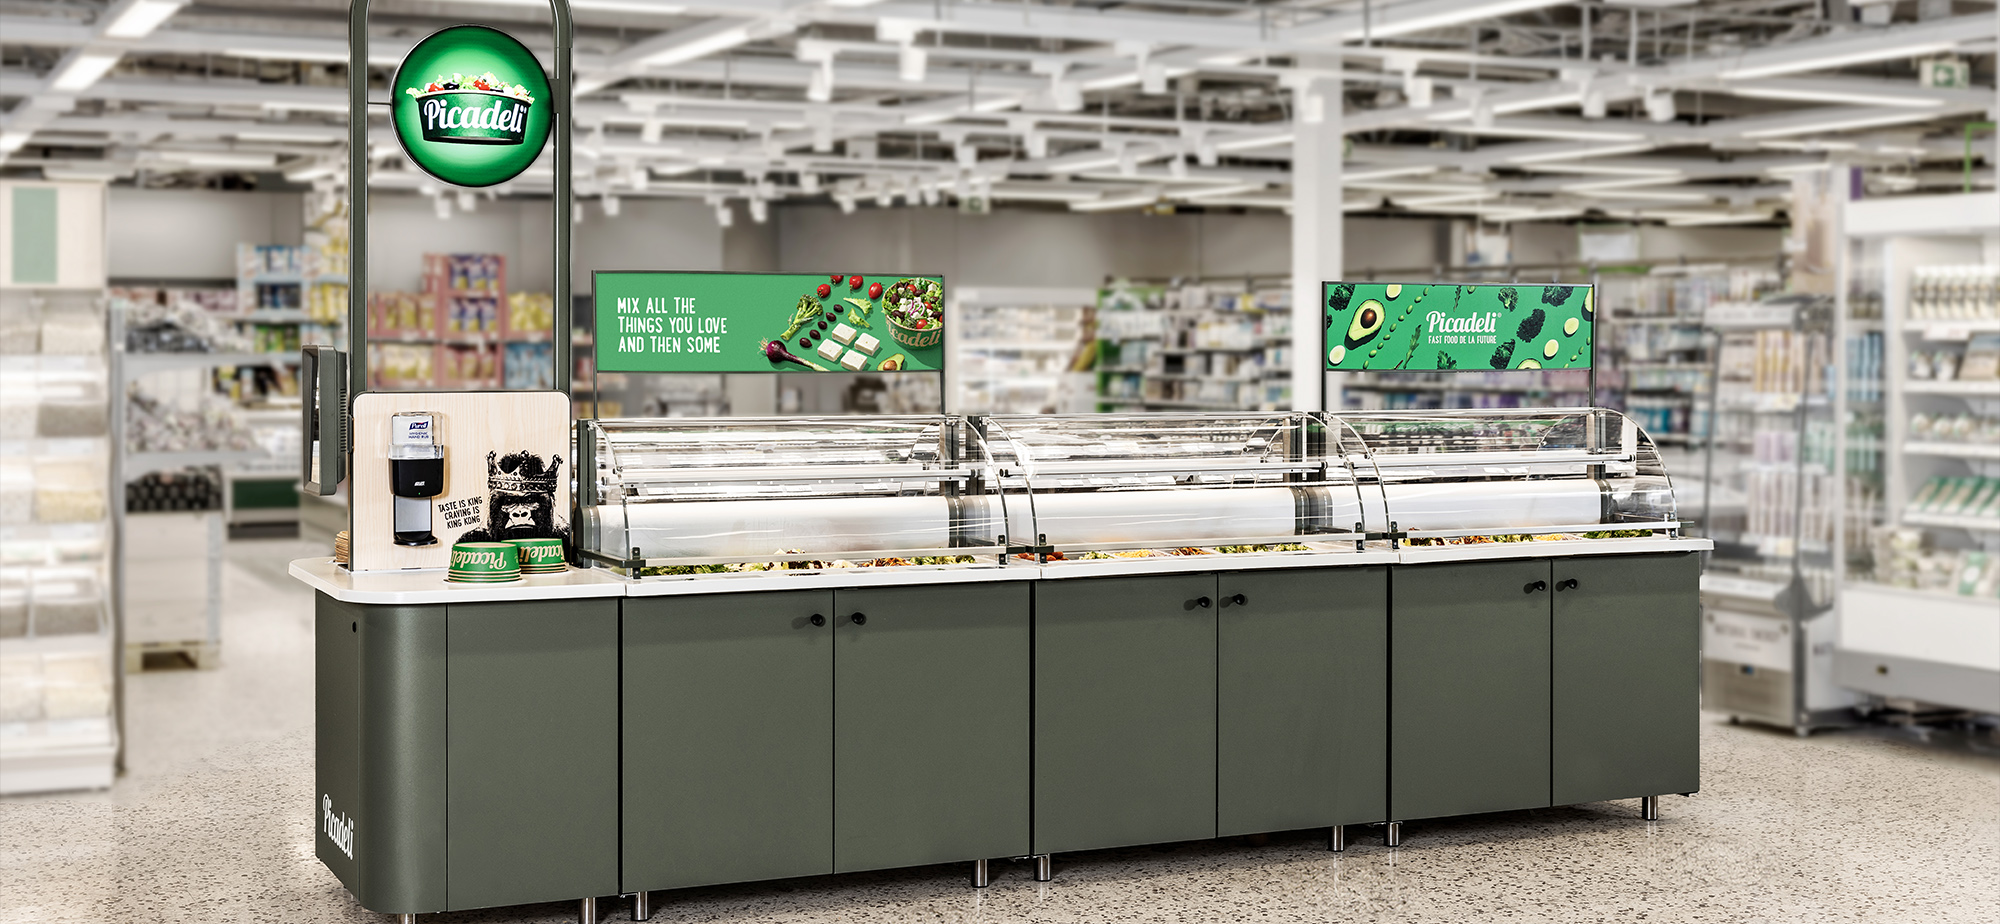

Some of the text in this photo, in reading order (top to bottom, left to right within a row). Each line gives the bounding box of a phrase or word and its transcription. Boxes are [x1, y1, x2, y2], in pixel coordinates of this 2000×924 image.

[424, 99, 524, 133] Picadeli
[617, 296, 696, 314] MIX ALL THE
[617, 316, 727, 334] THINGS YOU LOVE
[618, 335, 721, 353] AND THEN SOME
[1428, 335, 1497, 344] FAST FOOD DE LA FUTURE
[438, 496, 483, 513] TASTE IS KING
[444, 506, 480, 520] CRAVING IS
[447, 515, 480, 529] KING KONG
[322, 794, 353, 860] Picadeli
